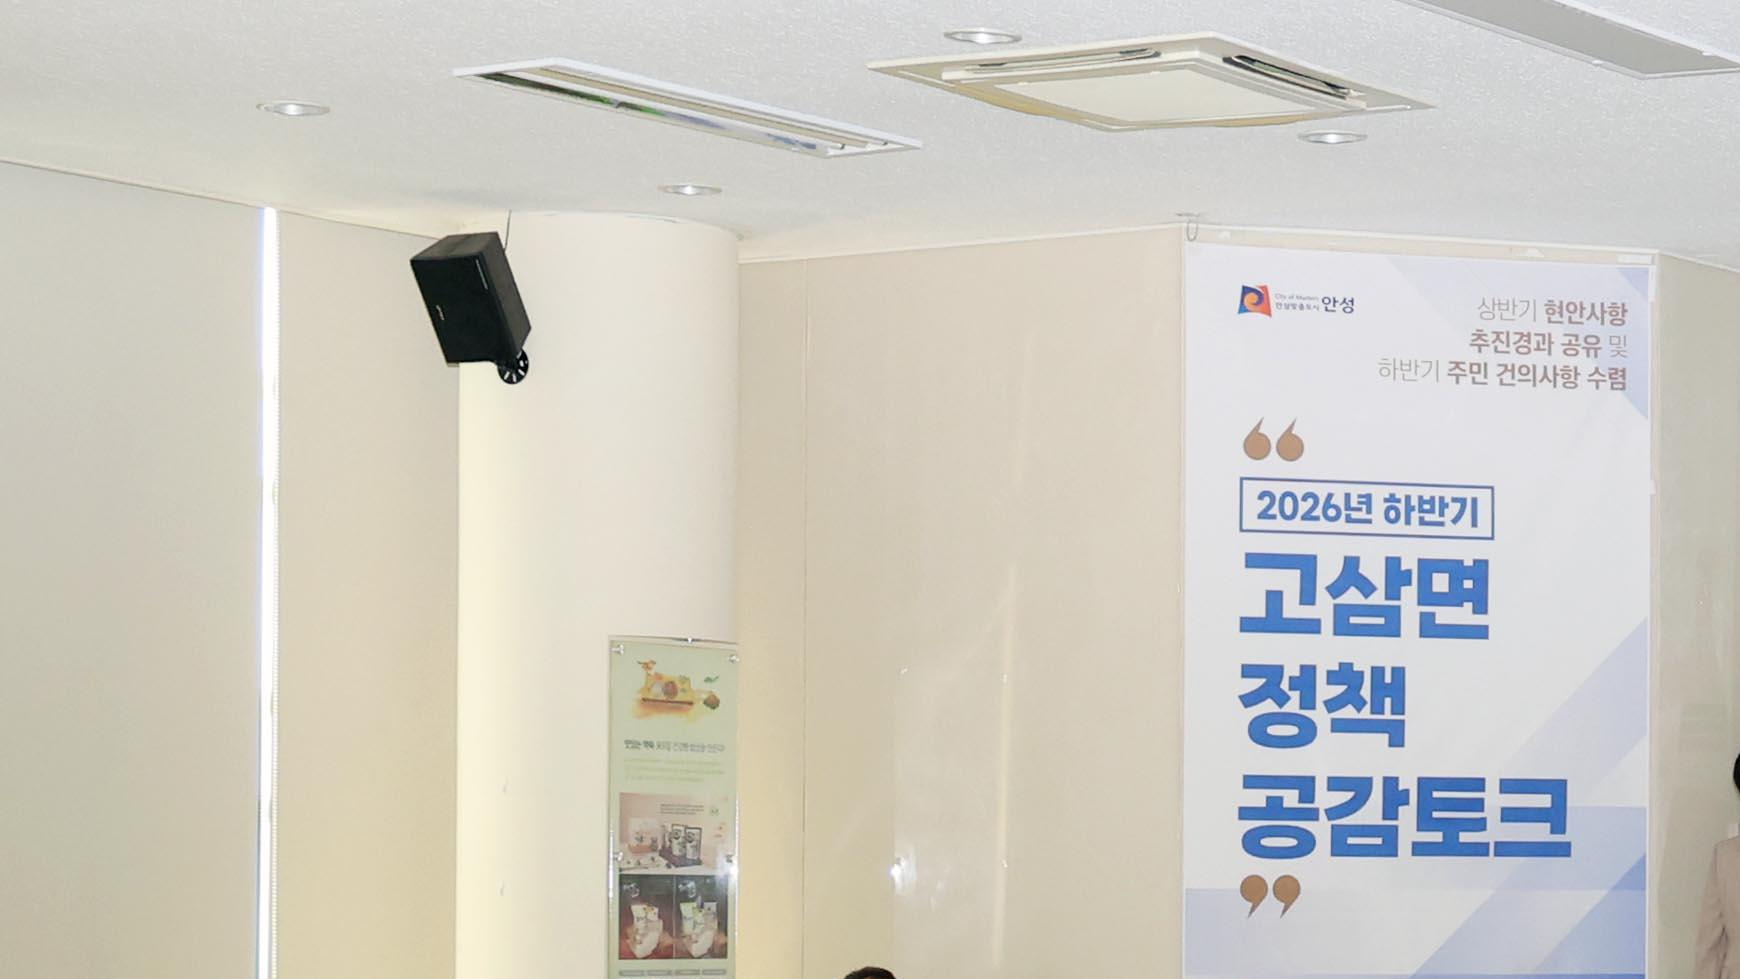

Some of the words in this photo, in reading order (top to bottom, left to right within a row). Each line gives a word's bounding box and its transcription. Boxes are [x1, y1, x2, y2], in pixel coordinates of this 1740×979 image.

[1321, 296, 1355, 314] 안성
[1477, 297, 1537, 322] 상반기
[1544, 299, 1628, 326] 현안사항
[1469, 328, 1554, 356] 추진경과
[1560, 332, 1603, 359] 공유
[1609, 334, 1627, 359] 및
[1378, 357, 1440, 383] 하반기
[1447, 360, 1488, 385] 주민
[1496, 363, 1581, 389] 건의사항
[1587, 366, 1627, 391] 수렴
[1256, 490, 1373, 524] 2026년
[1383, 493, 1479, 528] 하반기
[1239, 552, 1490, 640] 고삼면
[1238, 662, 1406, 749] 정책
[1237, 774, 1572, 860] 공감토크
